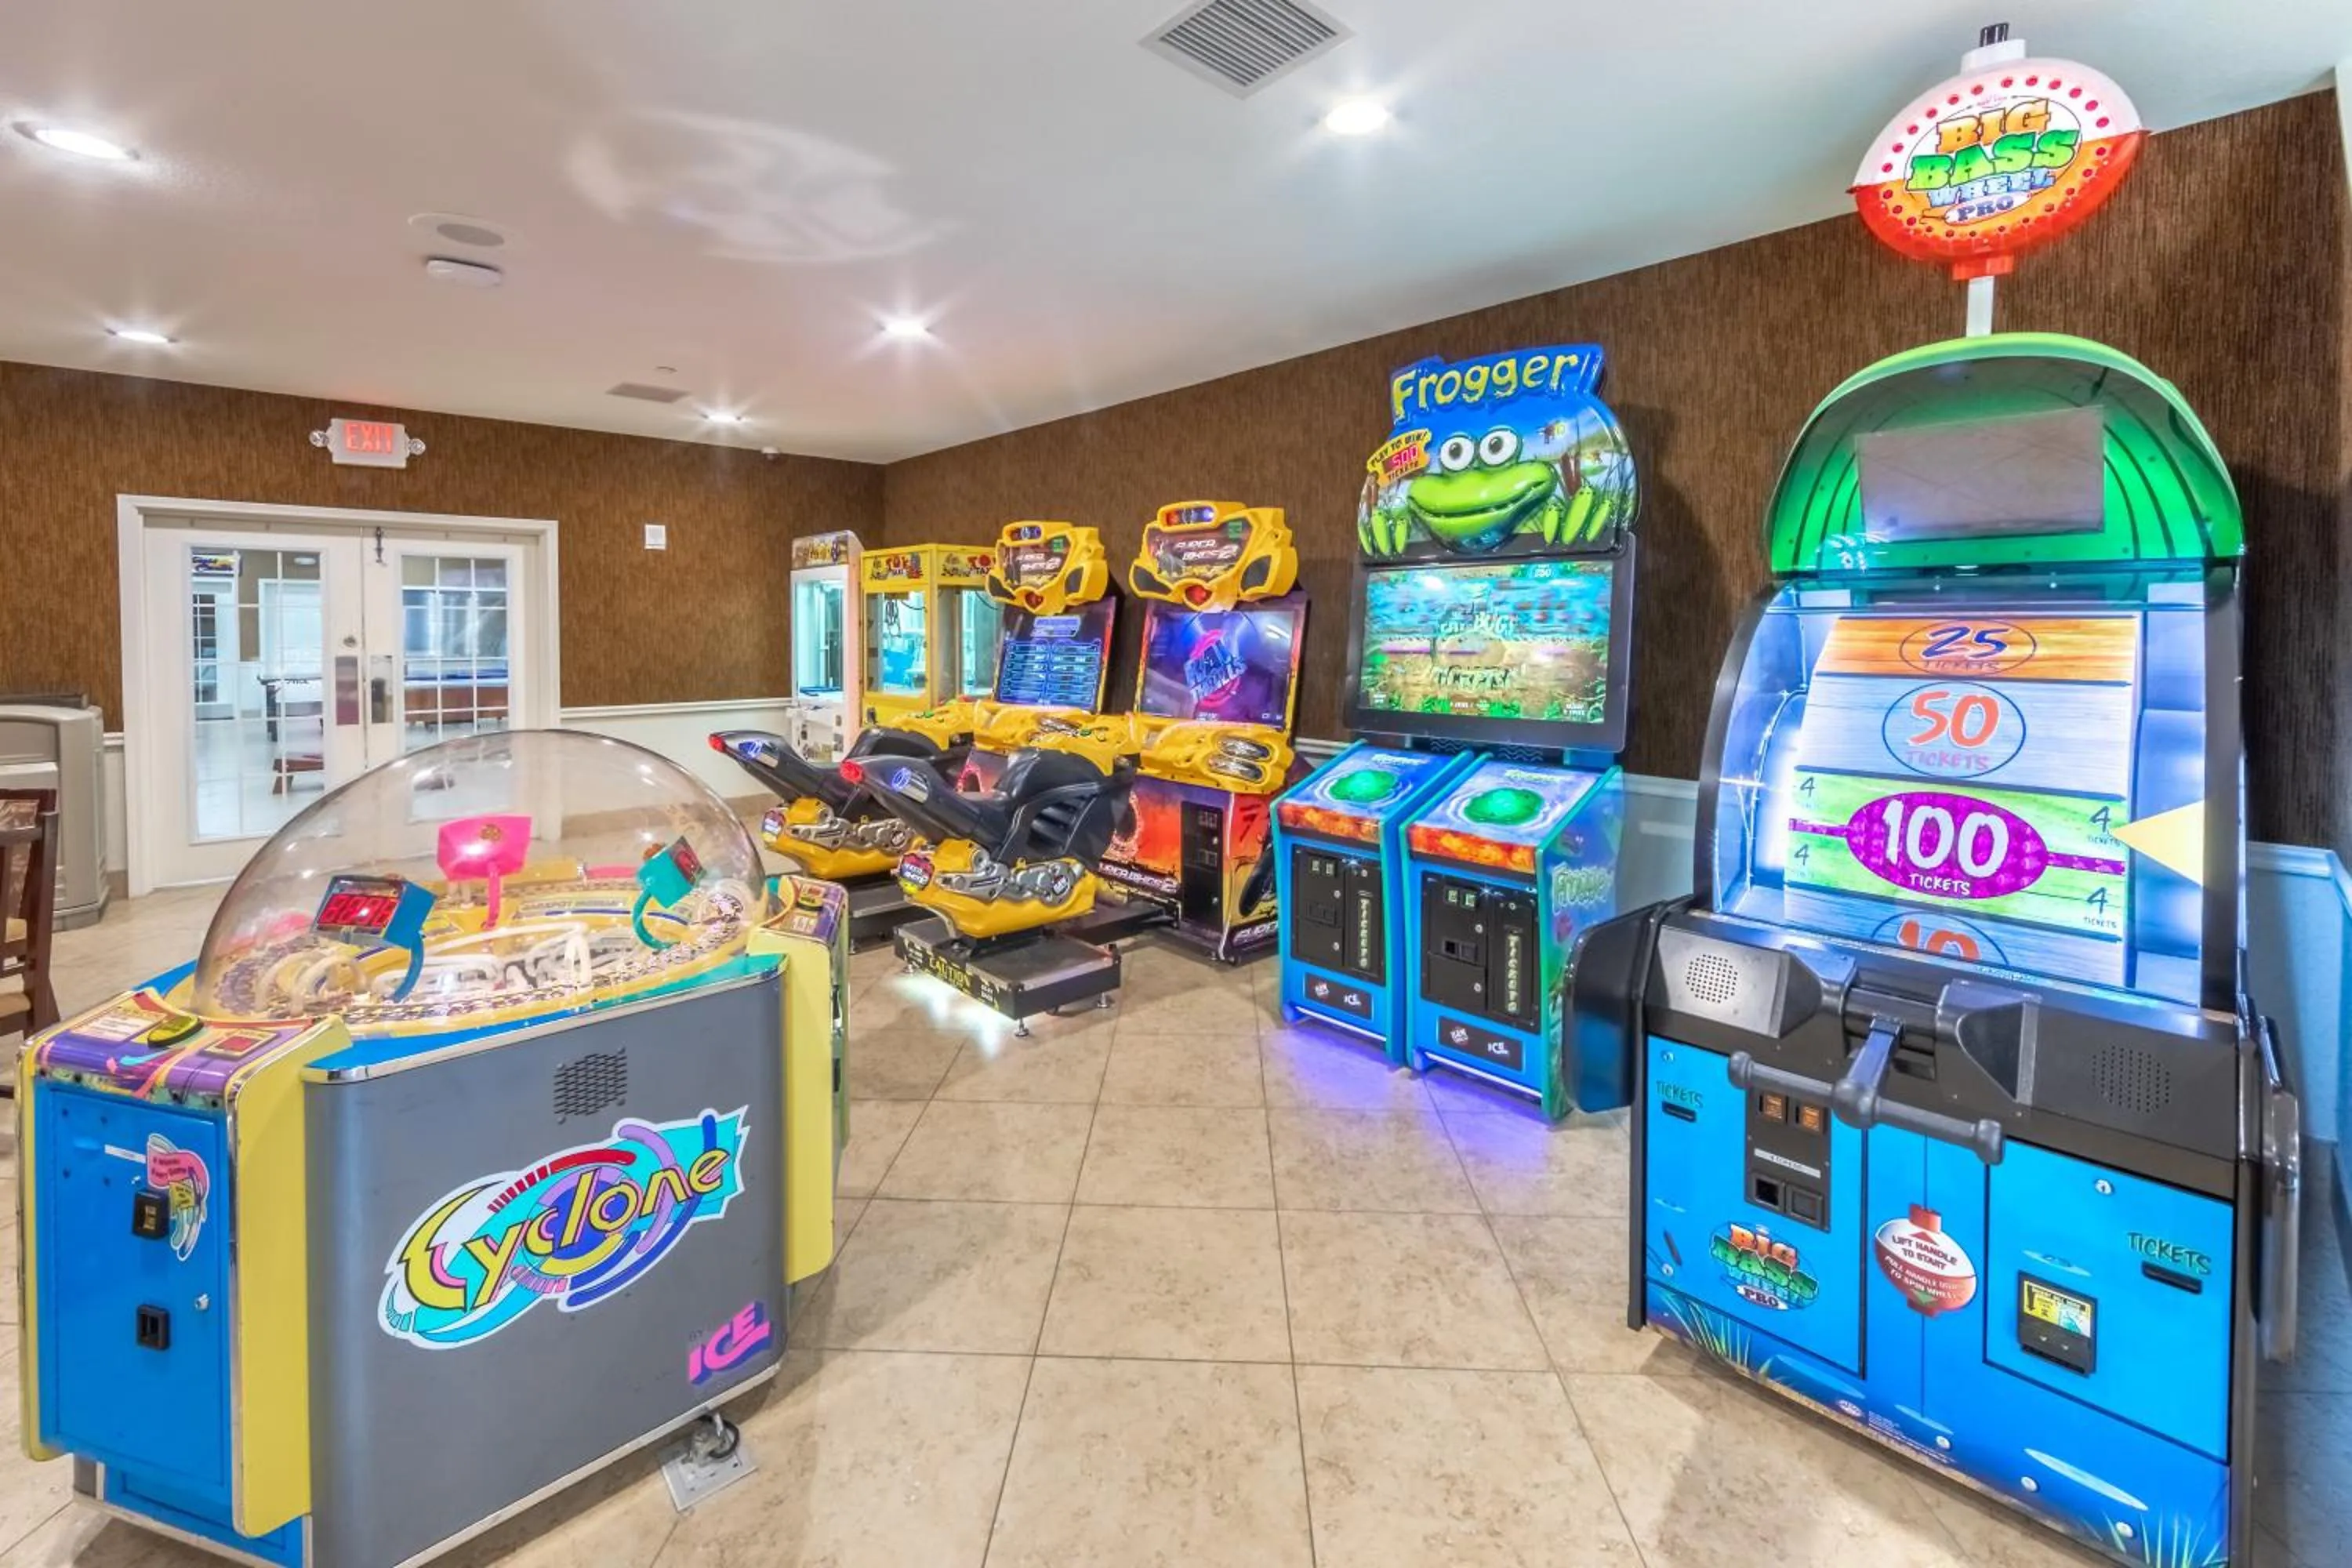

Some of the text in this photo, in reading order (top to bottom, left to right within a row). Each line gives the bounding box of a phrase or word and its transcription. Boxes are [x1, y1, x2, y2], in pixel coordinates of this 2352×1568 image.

[1936, 98, 2052, 154] BIG
[1905, 129, 2081, 191] BASS
[1926, 166, 2057, 208] WHEEL
[1957, 194, 2015, 222] PRO
[1392, 353, 1579, 423] Frogger
[346, 423, 391, 452] EXIT
[1921, 626, 2009, 660] 25
[1925, 659, 2002, 674] TICKETS
[1908, 690, 2001, 749] 50
[1906, 750, 1993, 771] TICKETS
[1800, 775, 1815, 798] 4
[2089, 805, 2111, 833] 4
[1882, 799, 2010, 878] 100
[1793, 843, 1809, 866] 4
[1908, 873, 1971, 895] TICKETS
[2085, 886, 2109, 915] 4
[2082, 916, 2118, 929] TICKETS
[1487, 1040, 1509, 1055] ICE
[1656, 1080, 1704, 1109] TICKETS
[397, 1148, 731, 1313] Cyclone
[1730, 1223, 1798, 1270] BIG
[1892, 1235, 1958, 1266] LIFT HANDLE
[1901, 1247, 1947, 1271] TO START
[2127, 1231, 2212, 1276] TICKETS
[1711, 1234, 1819, 1301] BASS
[1890, 1268, 1902, 1279] TO
[1904, 1278, 1926, 1292] SPIN
[1743, 1287, 1779, 1307] PRO
[688, 1301, 773, 1386] ICE
